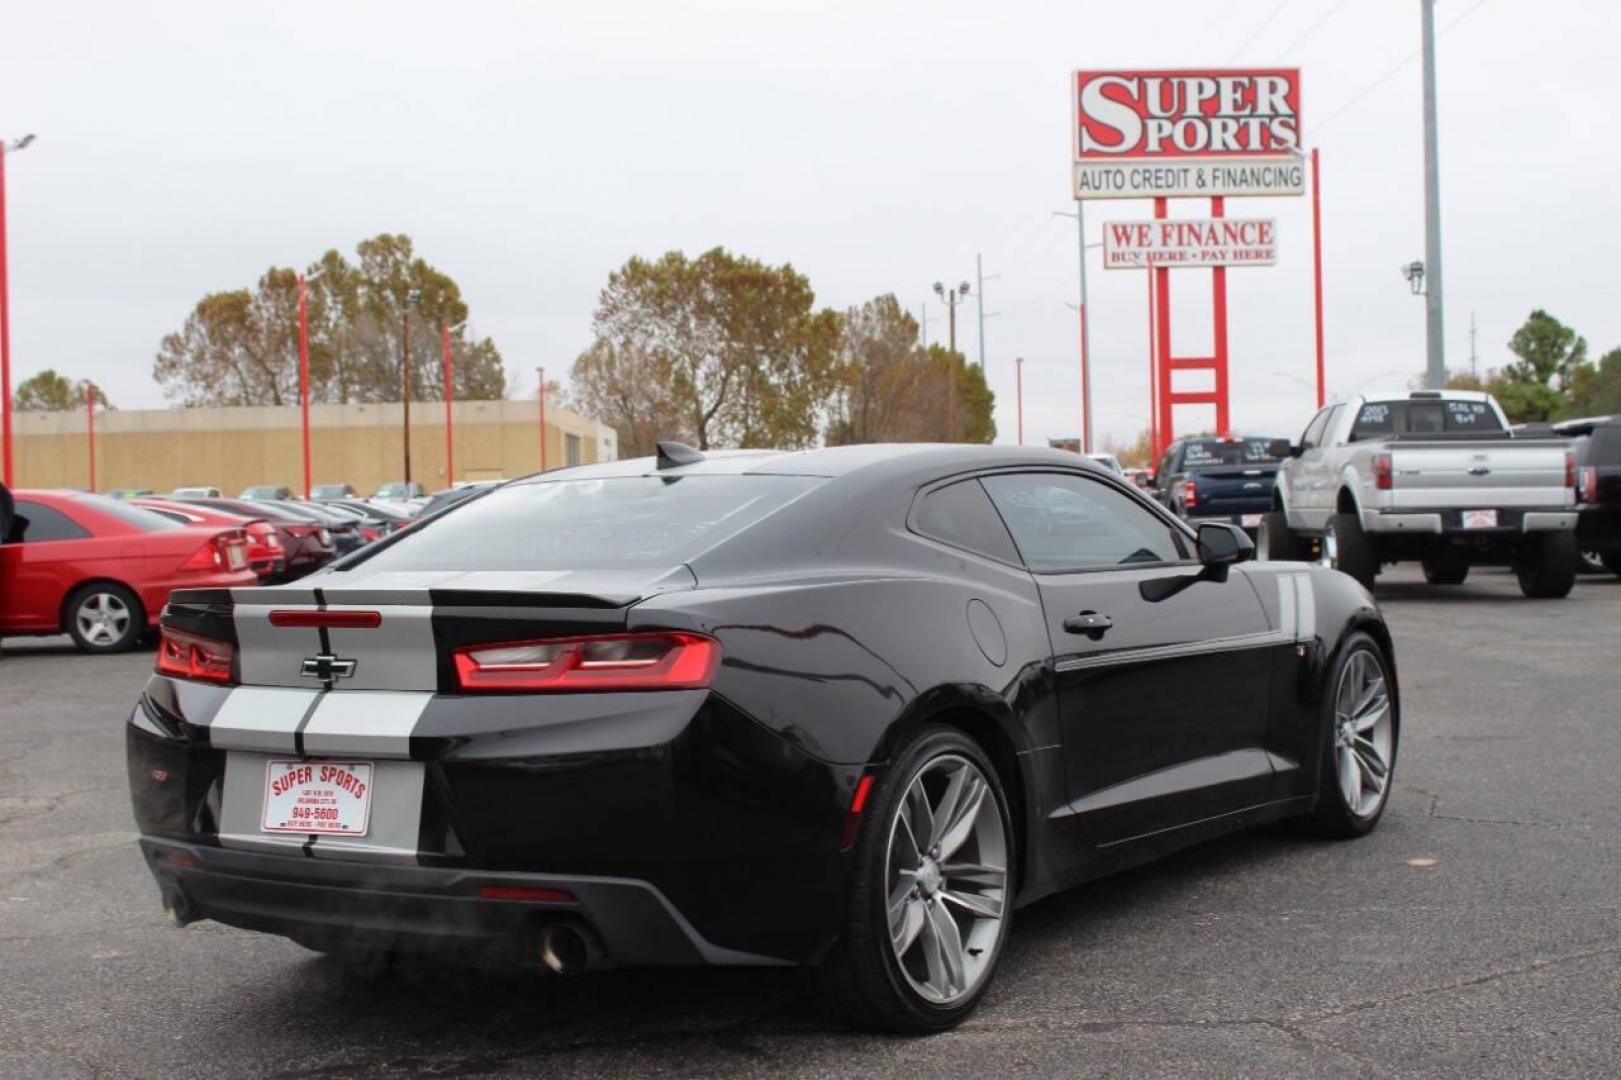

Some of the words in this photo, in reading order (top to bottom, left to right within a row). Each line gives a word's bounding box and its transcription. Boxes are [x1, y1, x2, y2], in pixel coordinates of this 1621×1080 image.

[1079, 169, 1126, 190] AUTO
[1130, 168, 1190, 189] CREDIT
[1196, 169, 1207, 188] &
[1212, 166, 1301, 188] FINANCING
[1111, 223, 1152, 248] WE
[1160, 221, 1274, 247] FINANCE
[1111, 252, 1142, 263] BUY
[1145, 250, 1189, 262] HERE
[1201, 250, 1229, 261] PAY
[1233, 249, 1275, 260] HERE
[272, 766, 313, 796] SUPER
[320, 766, 366, 799] SPORTS
[292, 806, 339, 820] 949-5600
